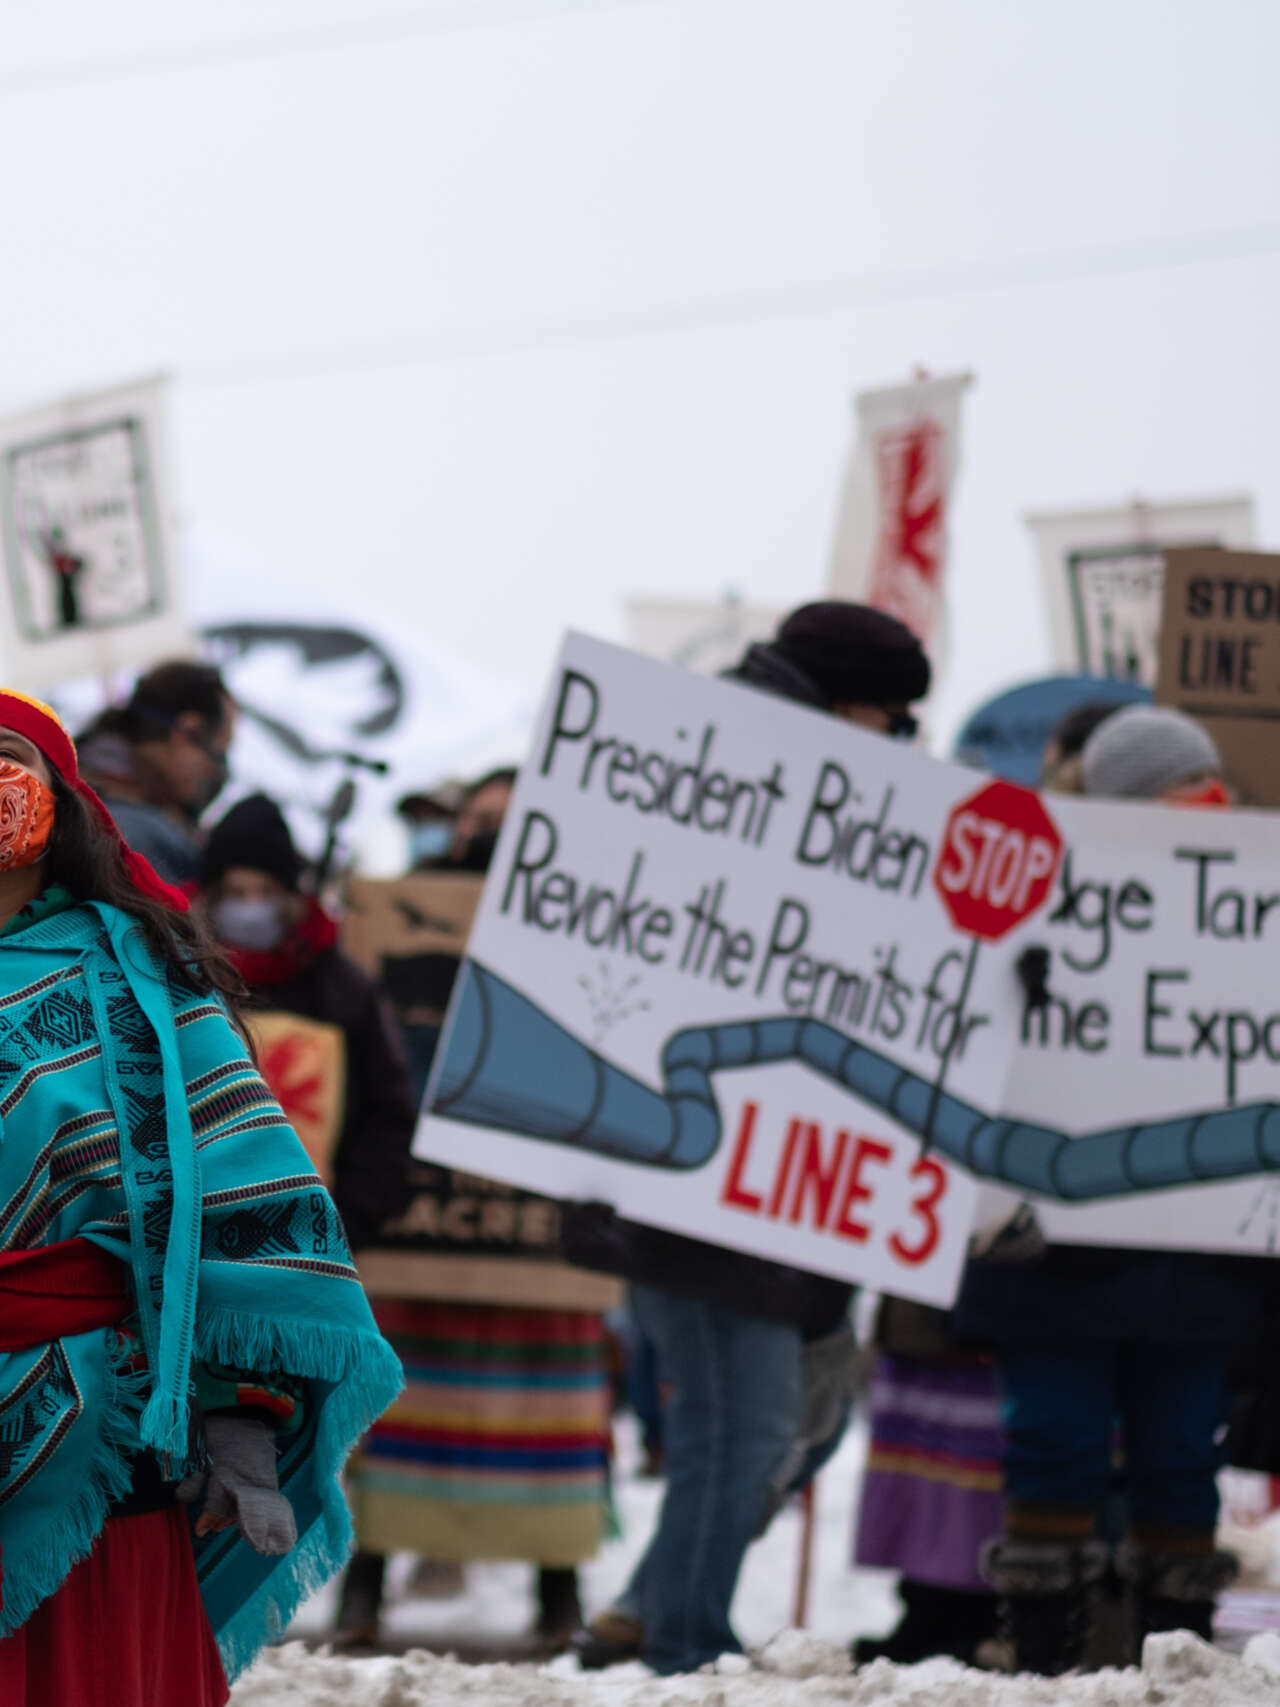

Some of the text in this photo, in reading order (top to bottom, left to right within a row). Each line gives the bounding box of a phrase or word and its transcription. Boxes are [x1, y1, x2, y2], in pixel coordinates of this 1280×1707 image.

[1178, 631, 1264, 695] LINE
[1185, 574, 1280, 622] STO
[539, 667, 931, 899] President Biden
[499, 808, 673, 964] Revoke
[680, 876, 755, 988] the
[755, 896, 914, 1040] Permits
[941, 811, 1053, 912] STOP
[720, 1100, 949, 1269] LINE 3
